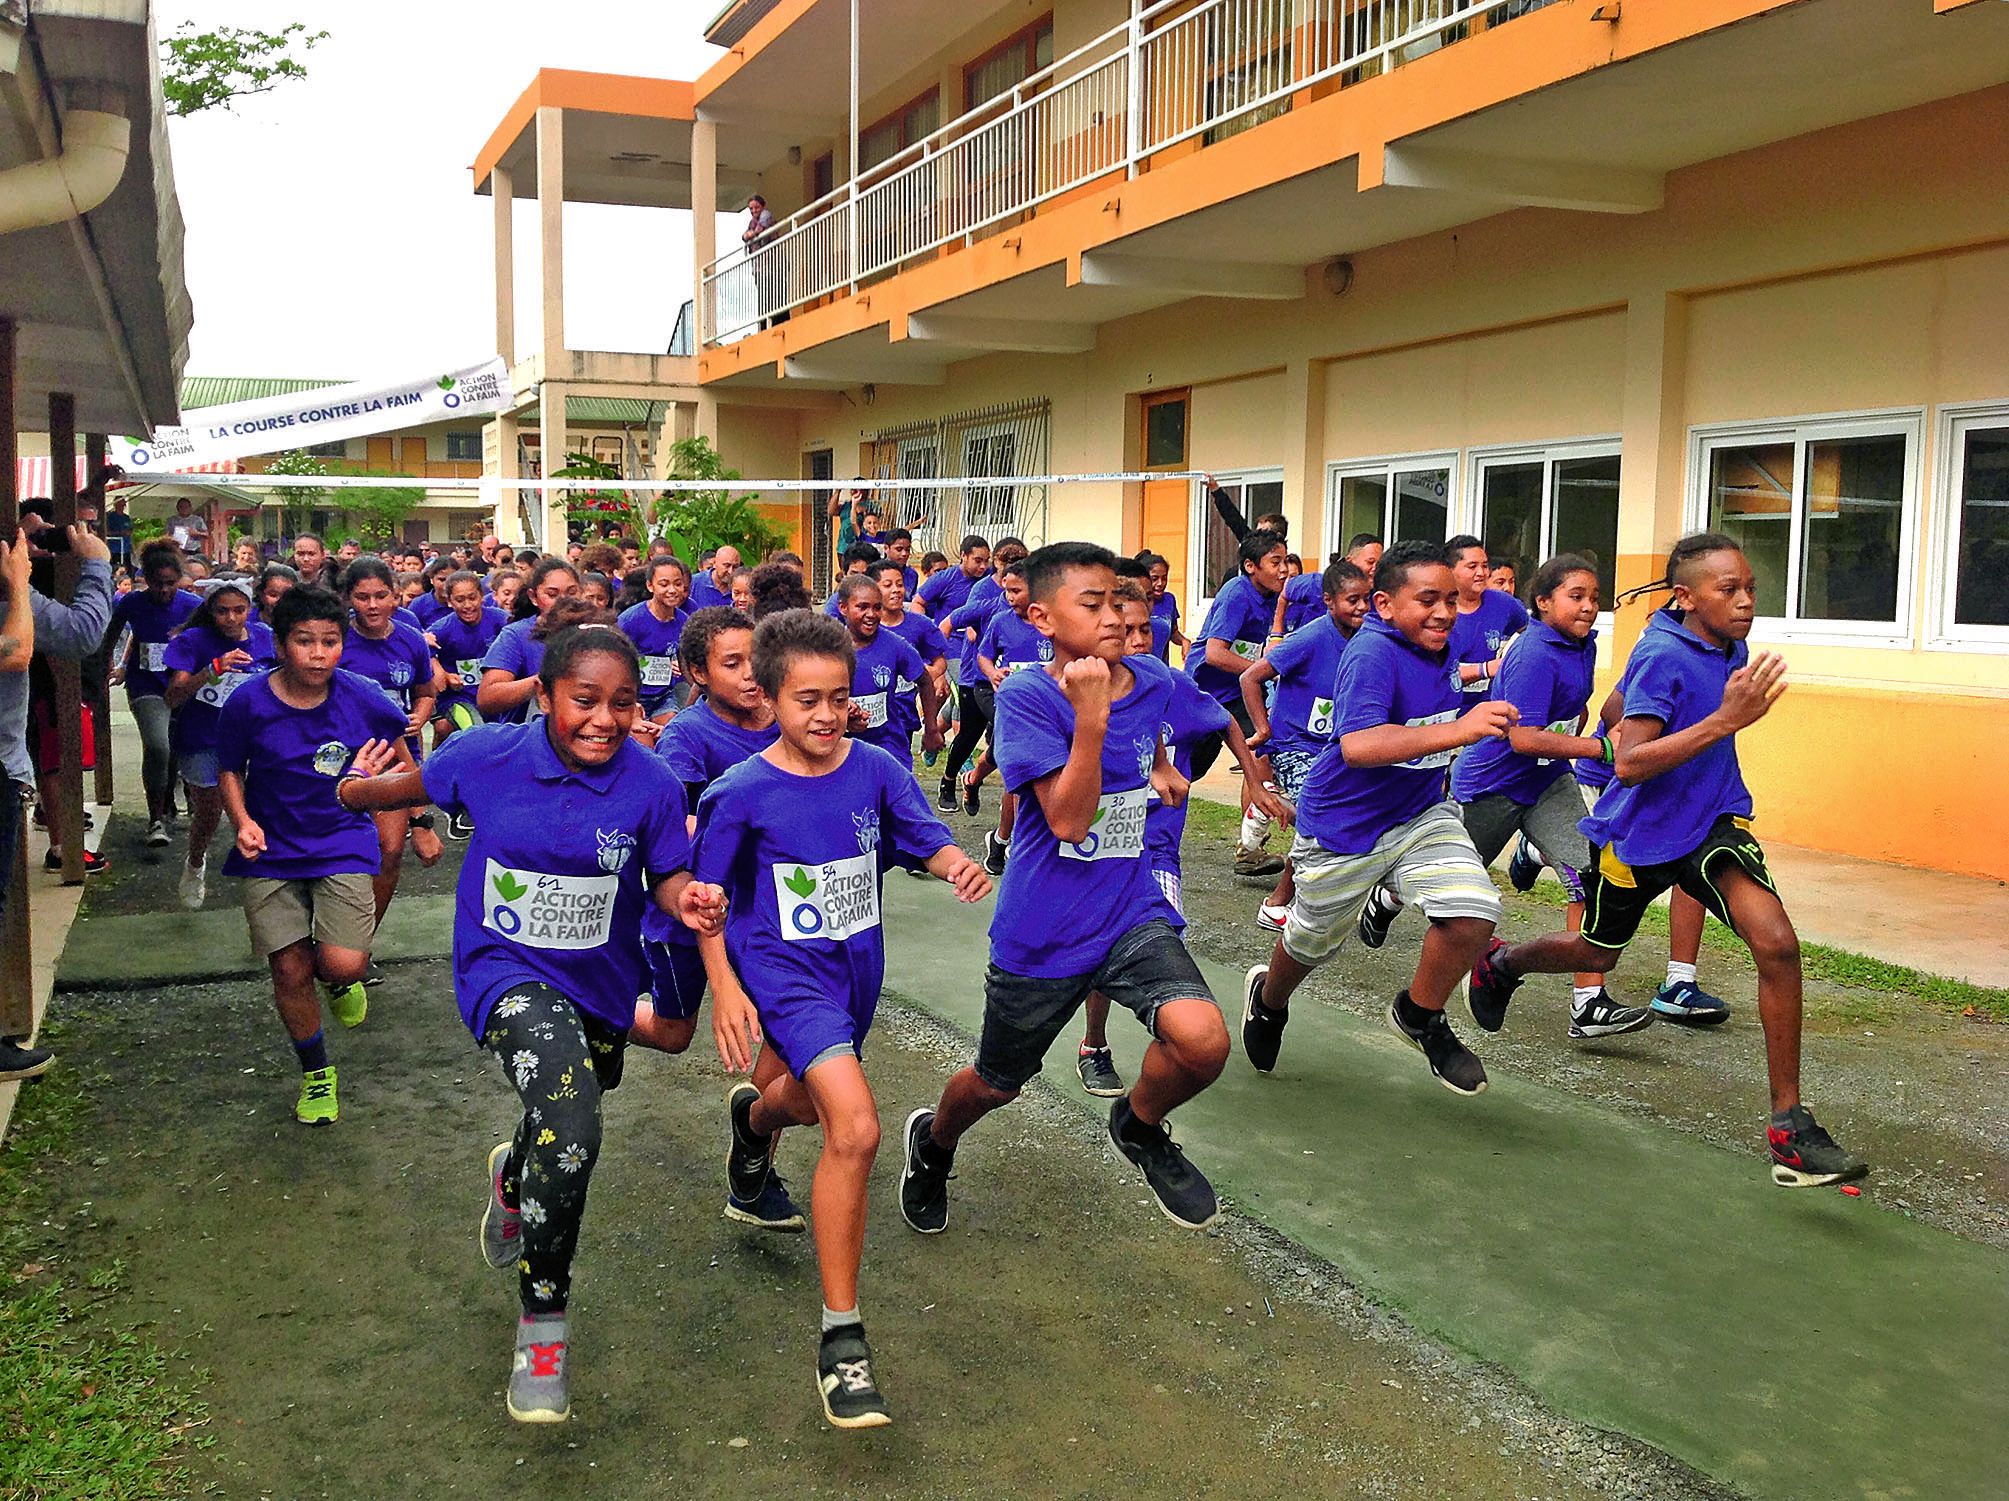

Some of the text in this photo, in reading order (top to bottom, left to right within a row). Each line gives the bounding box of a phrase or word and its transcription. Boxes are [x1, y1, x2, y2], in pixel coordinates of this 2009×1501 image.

[460, 373, 496, 386] ACTION
[461, 381, 499, 394] CONTRE
[463, 389, 501, 403] LA FAIM
[209, 391, 423, 439] LA COURSE CONTRE LA FAIM
[153, 444, 194, 459] LA FAIM
[1111, 796, 1125, 808] 30
[1108, 804, 1145, 821] ACTIO
[1103, 836, 1119, 849] LA
[822, 865, 836, 881] 54
[537, 875, 563, 890] 61
[823, 869, 872, 897] ACTION
[531, 890, 609, 908] ACTION
[824, 885, 872, 914] CONTRE
[530, 907, 605, 923] CONTRE
[827, 901, 873, 931] LA FAIM
[528, 921, 602, 940] LA FAIM
